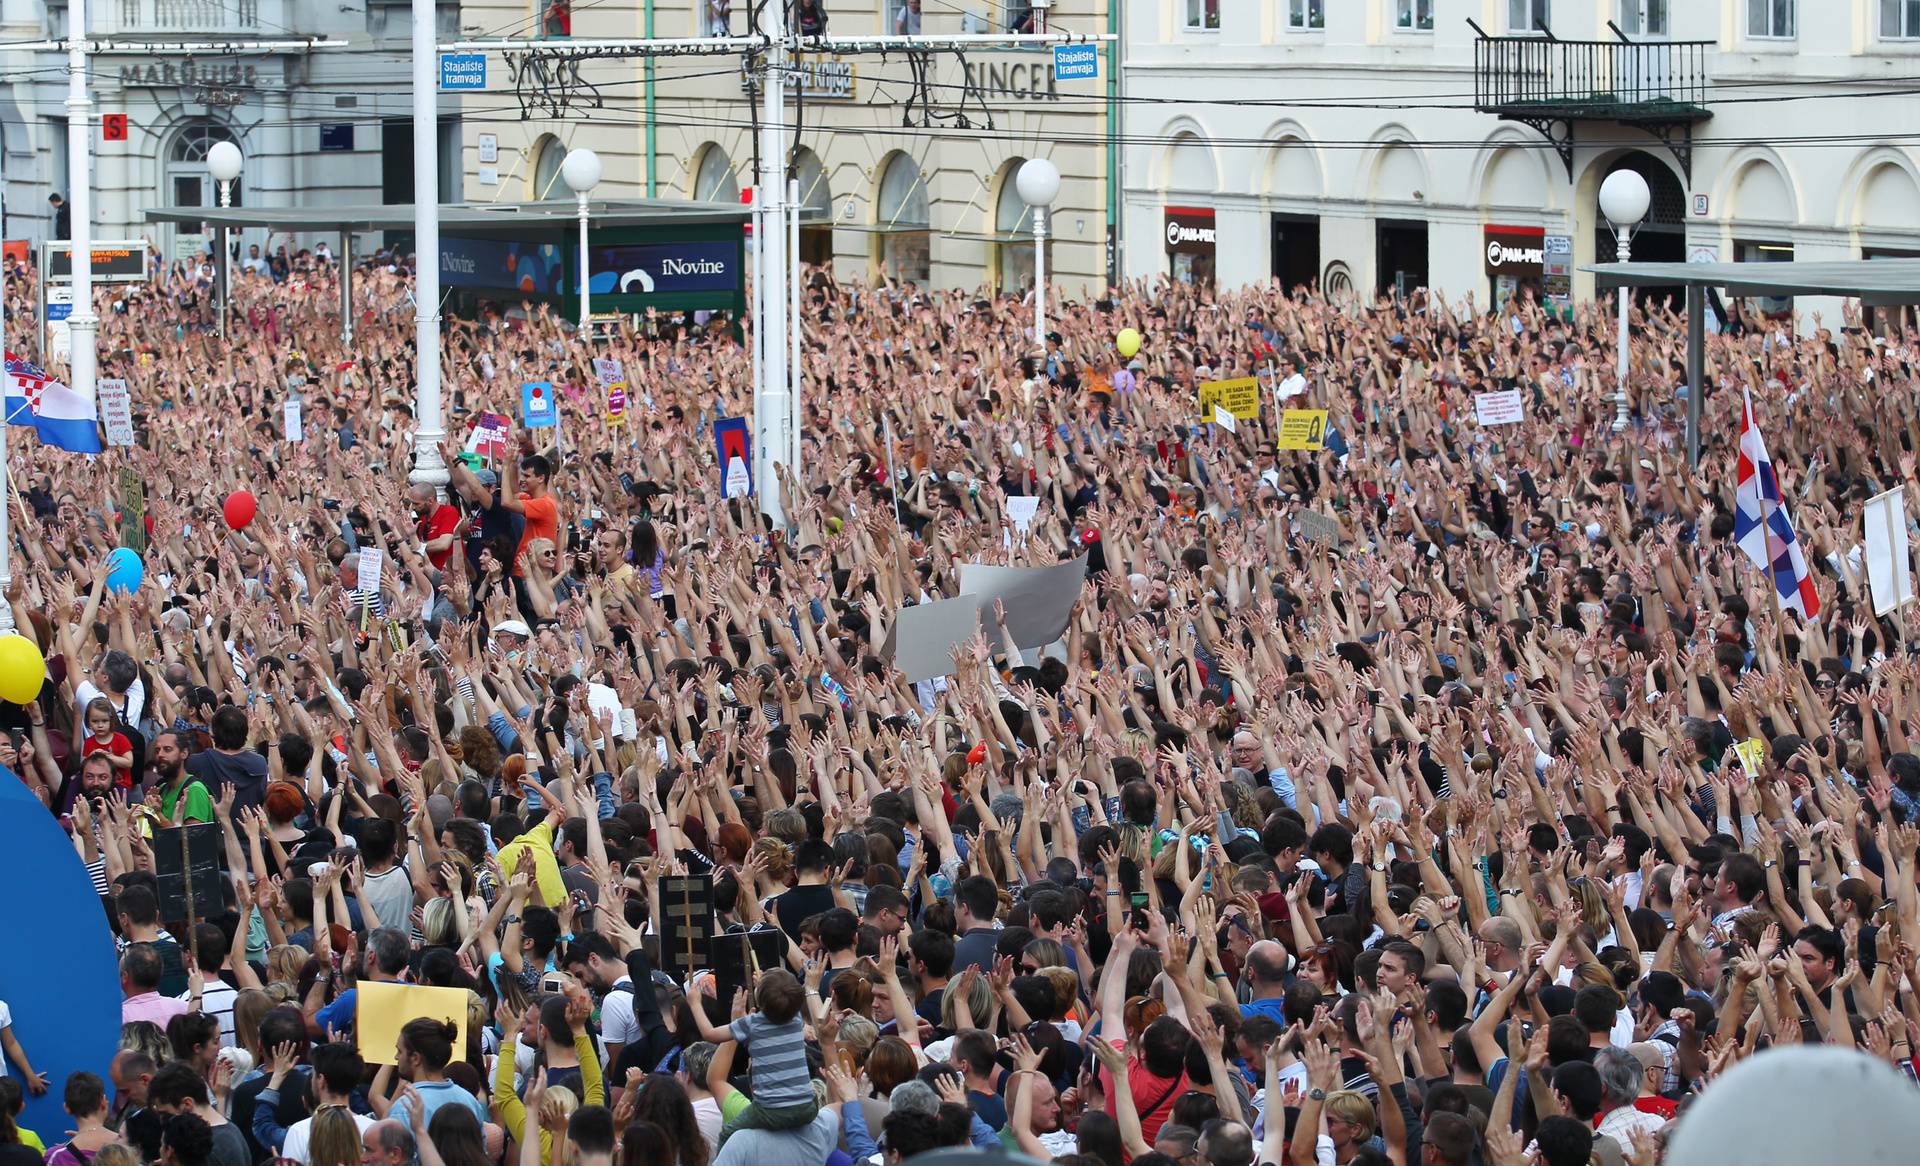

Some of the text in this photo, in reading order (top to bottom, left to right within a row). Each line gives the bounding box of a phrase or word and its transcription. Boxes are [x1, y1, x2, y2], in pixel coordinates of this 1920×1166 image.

[1057, 51, 1095, 64] Stajalište
[444, 60, 484, 74] Stajalište
[814, 56, 852, 94] knjiga
[1059, 63, 1094, 75] tramvaja
[445, 73, 482, 86] tramvaja
[966, 62, 1060, 101] SINGER
[109, 116, 121, 138] S
[1179, 226, 1216, 243] PAN-PEK
[442, 251, 475, 273] iNovine
[1501, 247, 1544, 264] PAN-PEK
[662, 258, 725, 276] iNovine
